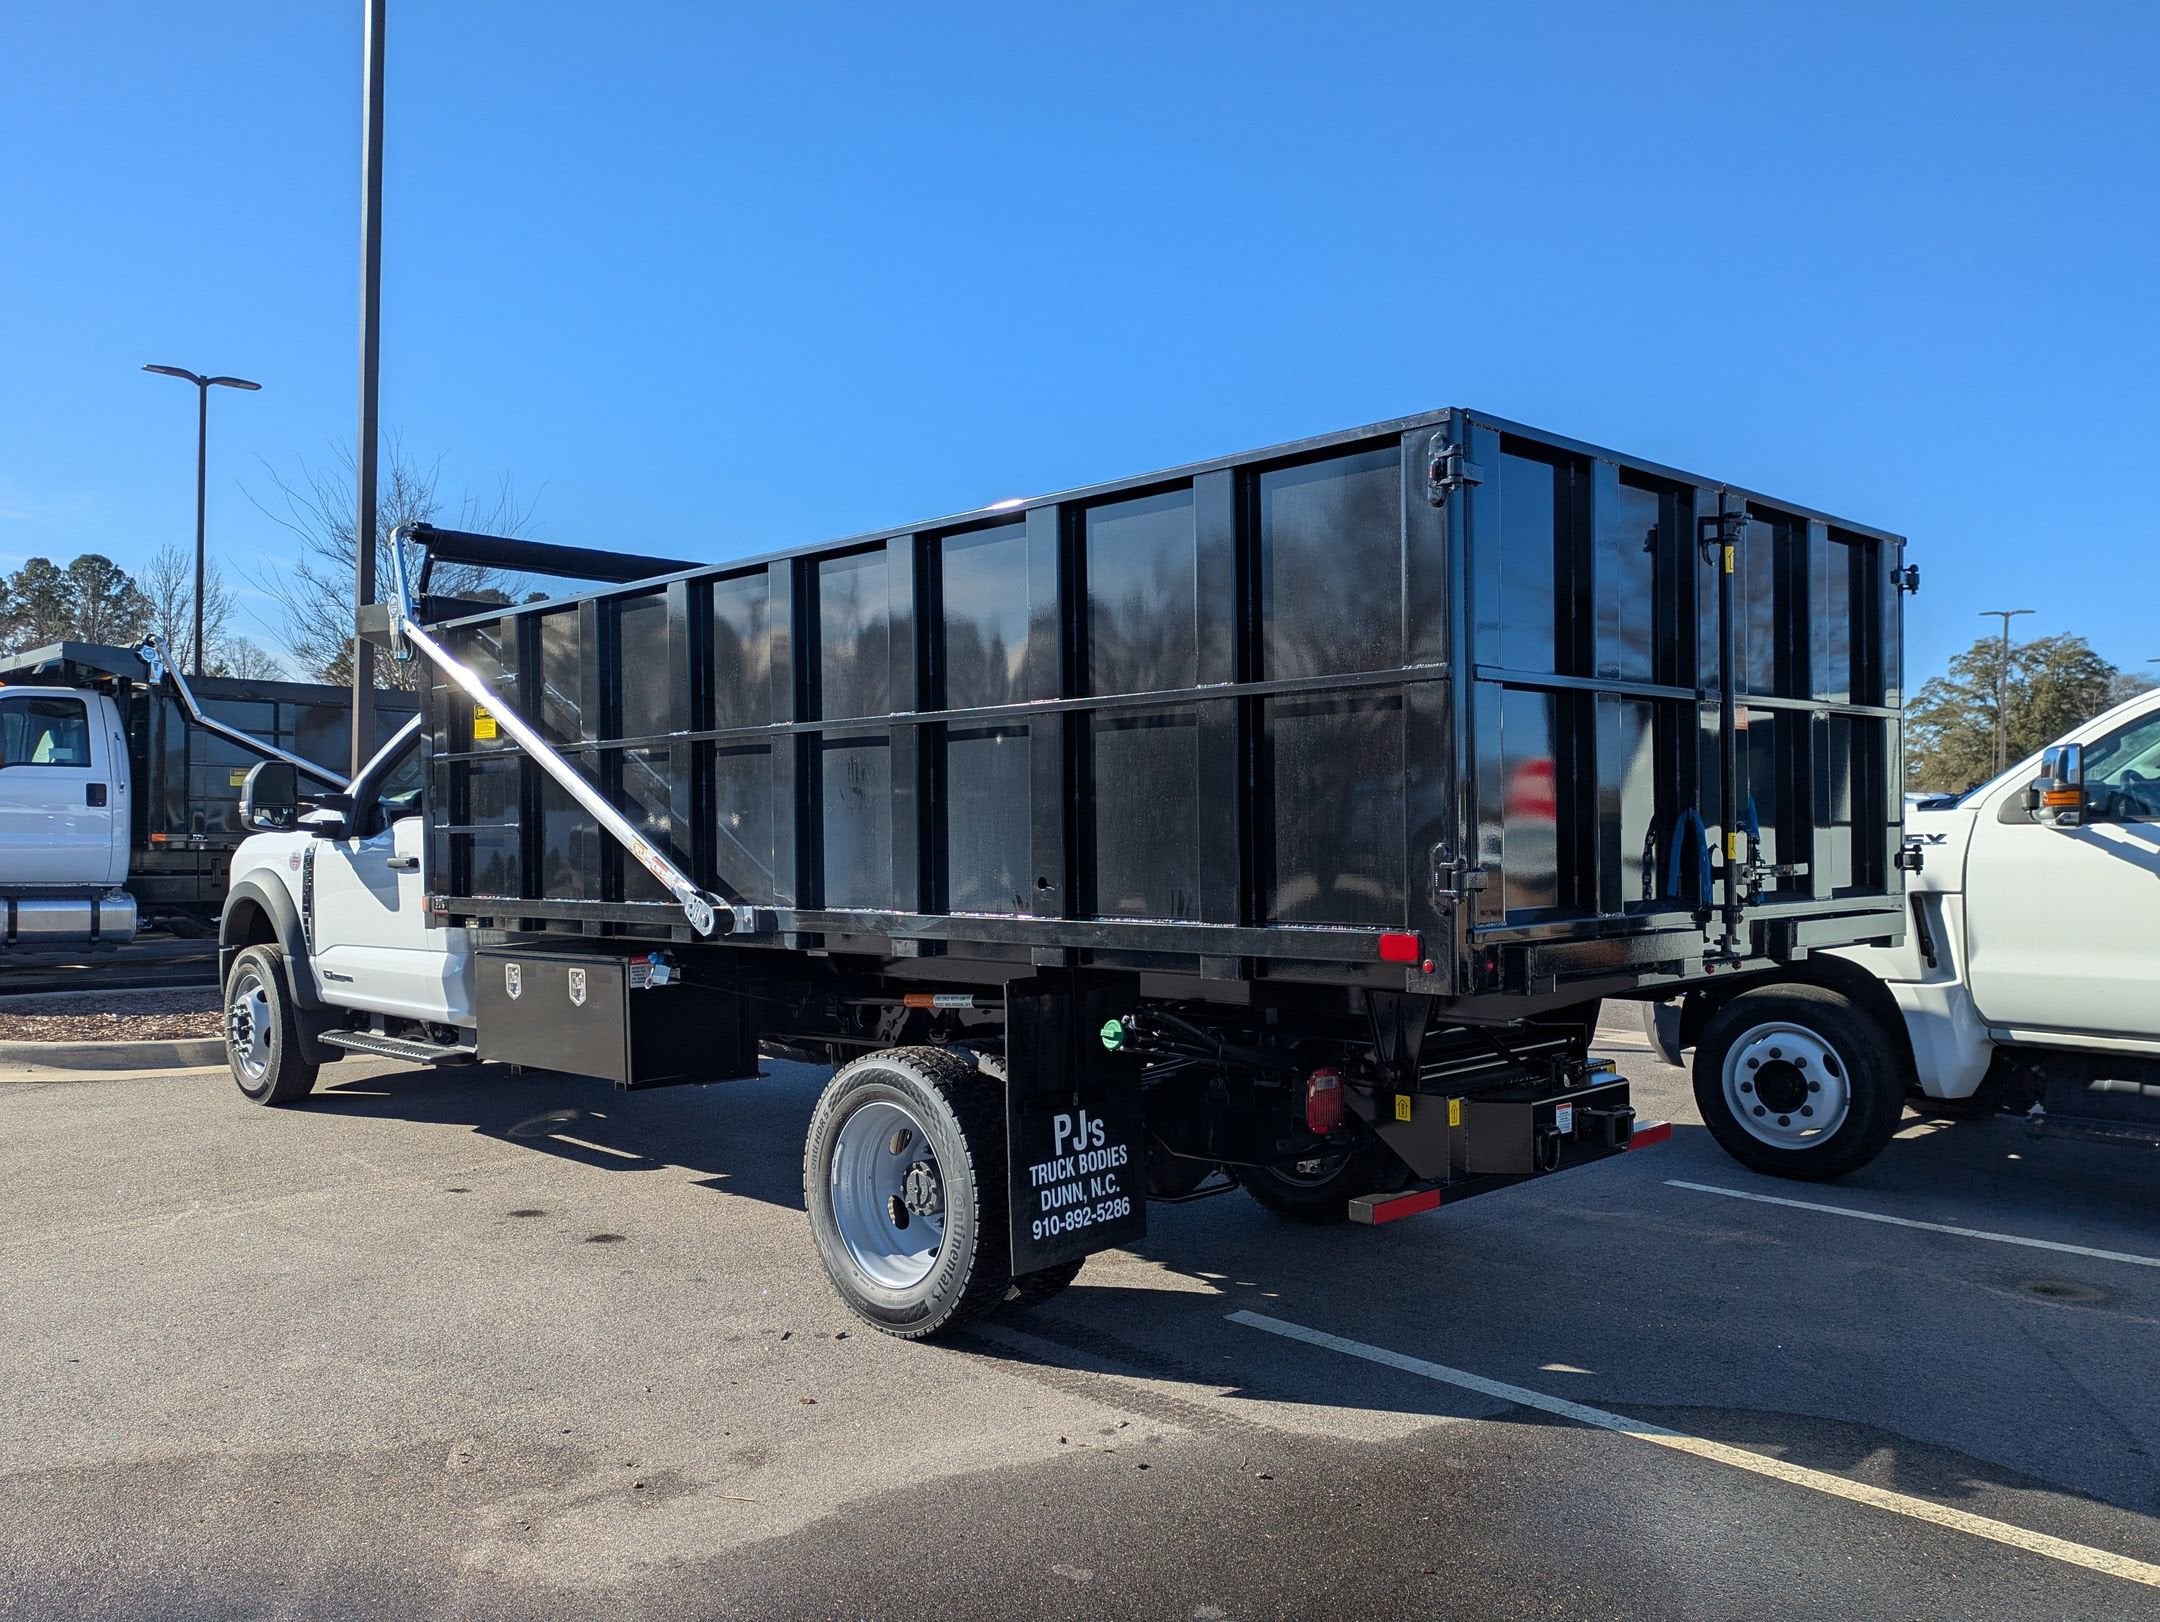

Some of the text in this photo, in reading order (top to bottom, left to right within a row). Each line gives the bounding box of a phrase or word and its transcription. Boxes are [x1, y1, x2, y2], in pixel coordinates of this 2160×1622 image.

[1054, 1110, 1105, 1156] PJ's
[1029, 1144, 1128, 1187] TRUCK BODIES
[1041, 1173, 1120, 1211] DUNN, N.C.
[1032, 1196, 1130, 1240] 910-892-5286
